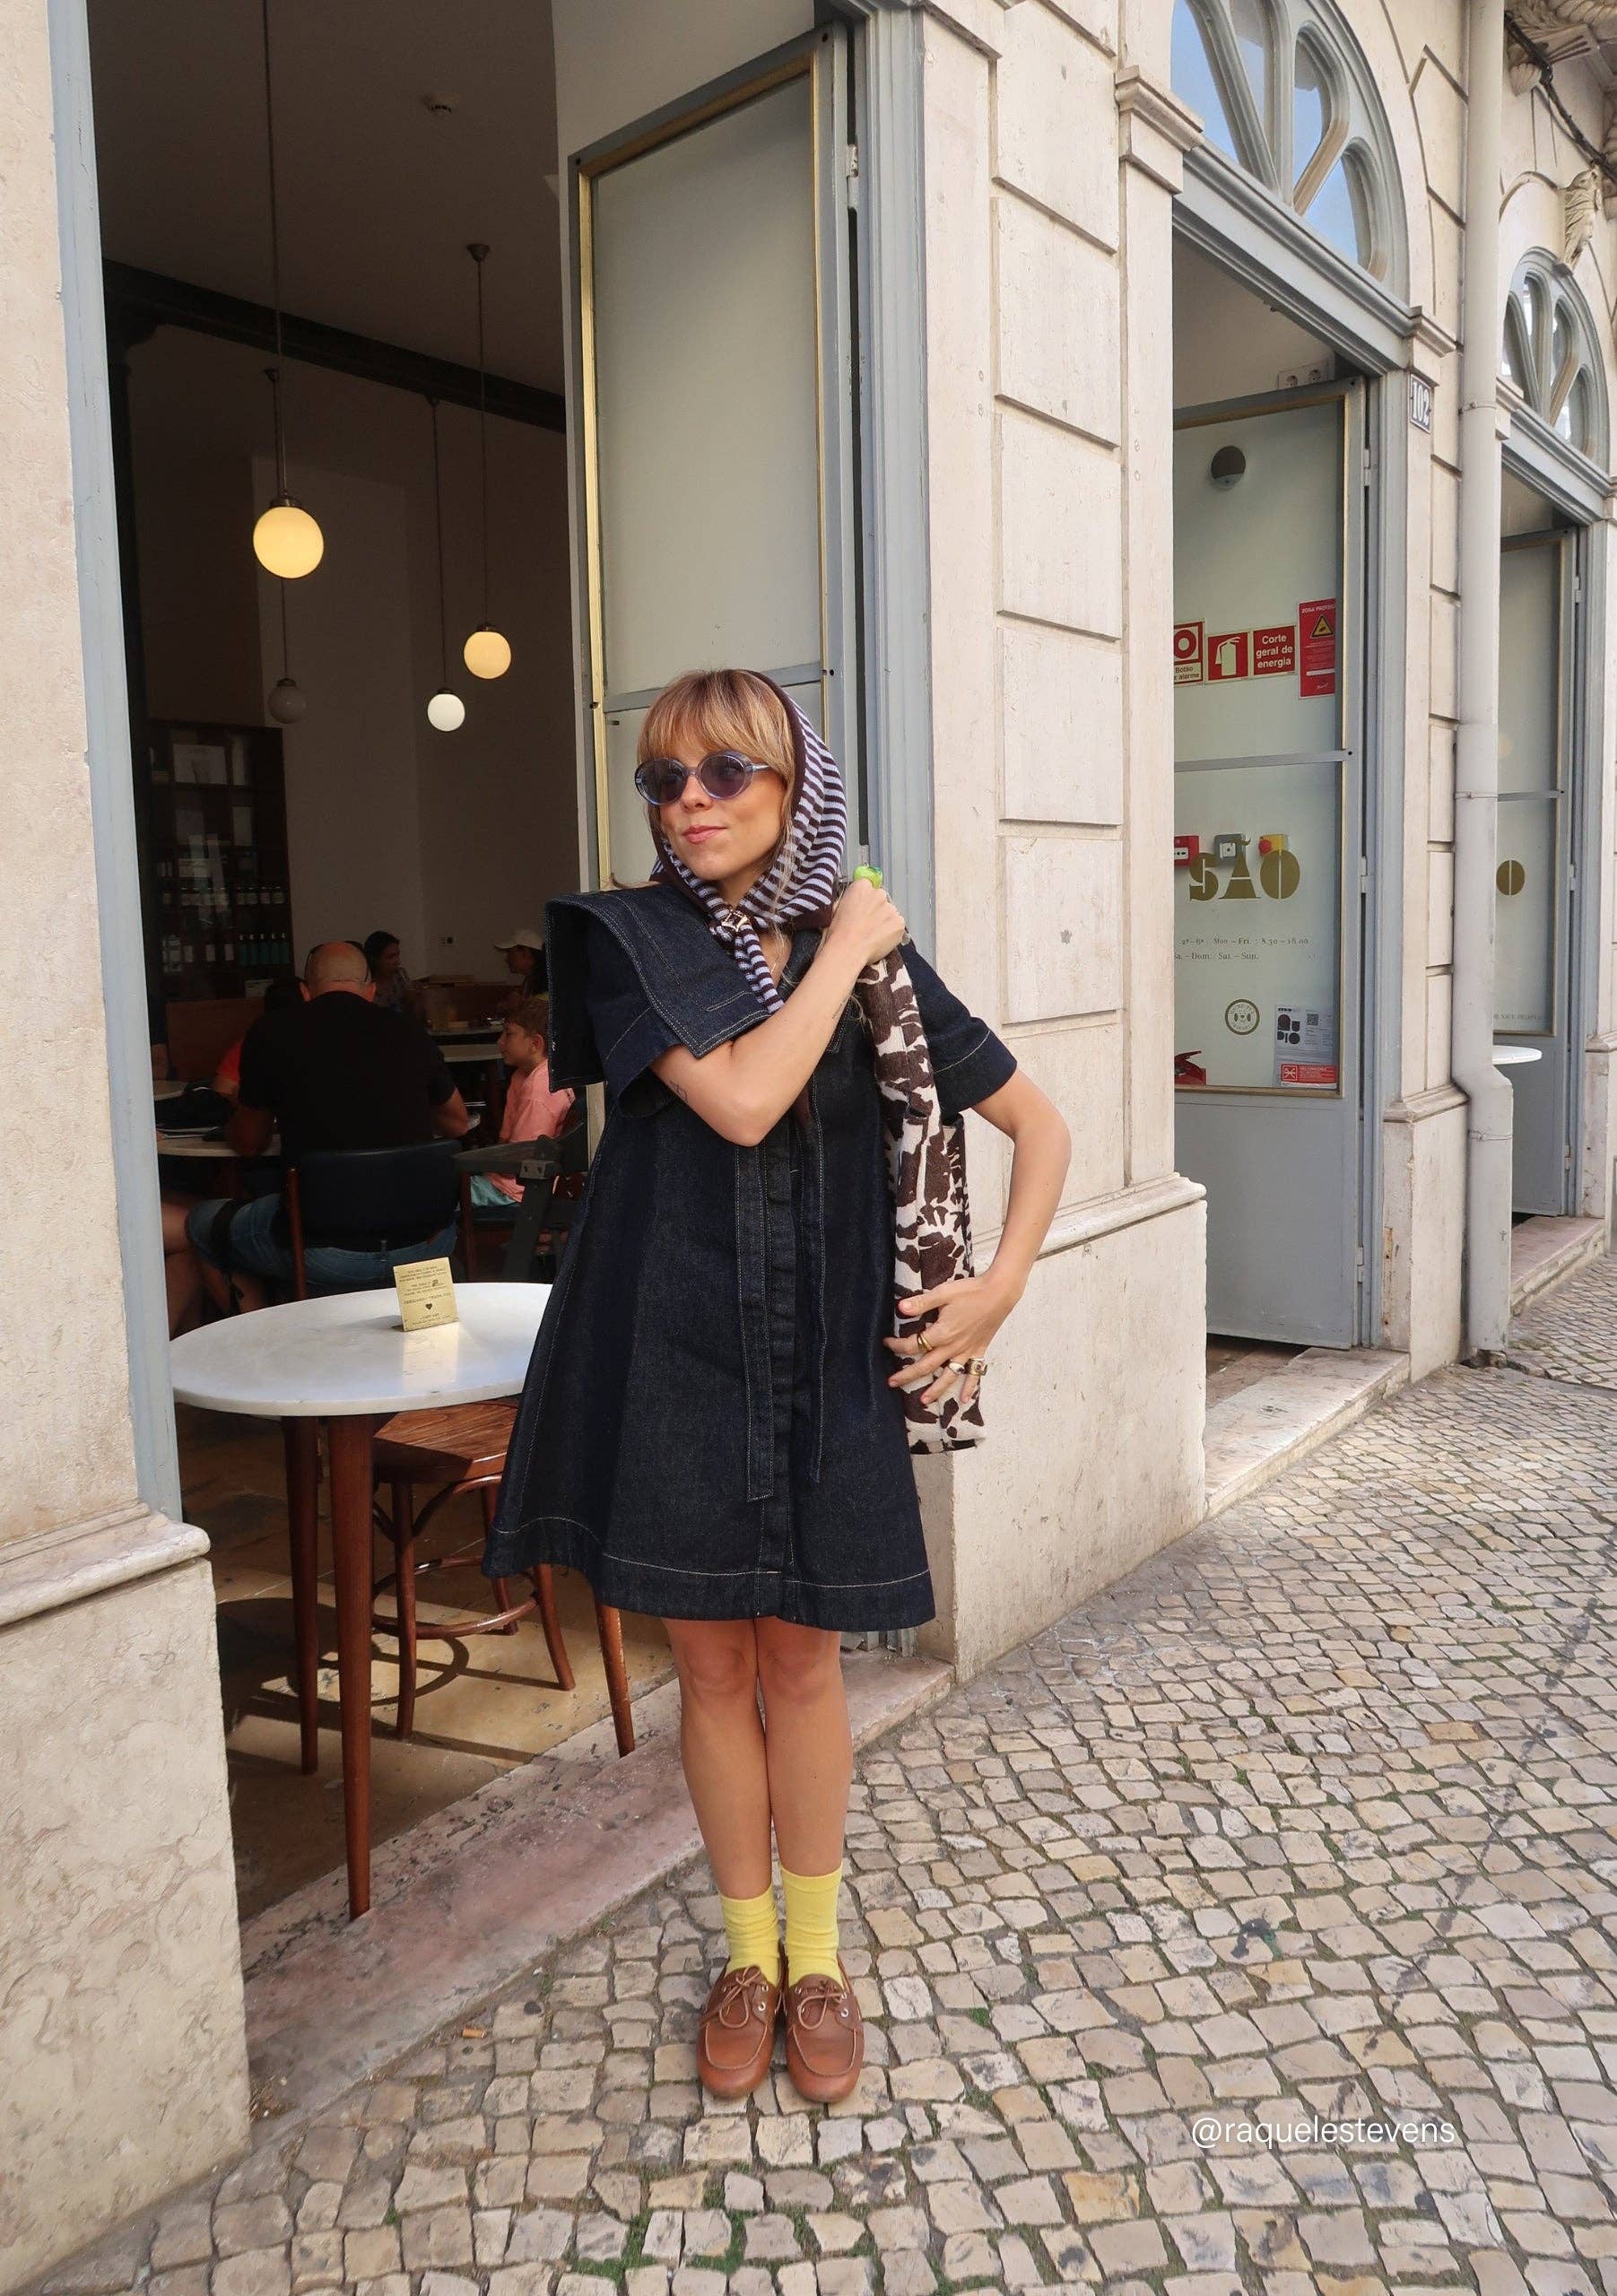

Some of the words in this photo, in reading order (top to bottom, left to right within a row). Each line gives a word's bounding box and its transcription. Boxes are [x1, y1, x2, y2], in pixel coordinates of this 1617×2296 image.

[1413, 381, 1430, 426] 102
[1262, 634, 1287, 645] Corte
[1256, 646, 1279, 659] geral
[1281, 645, 1293, 654] de
[1175, 665, 1194, 674] Botão
[1257, 657, 1291, 669] energia
[1189, 837, 1300, 901] SÃO
